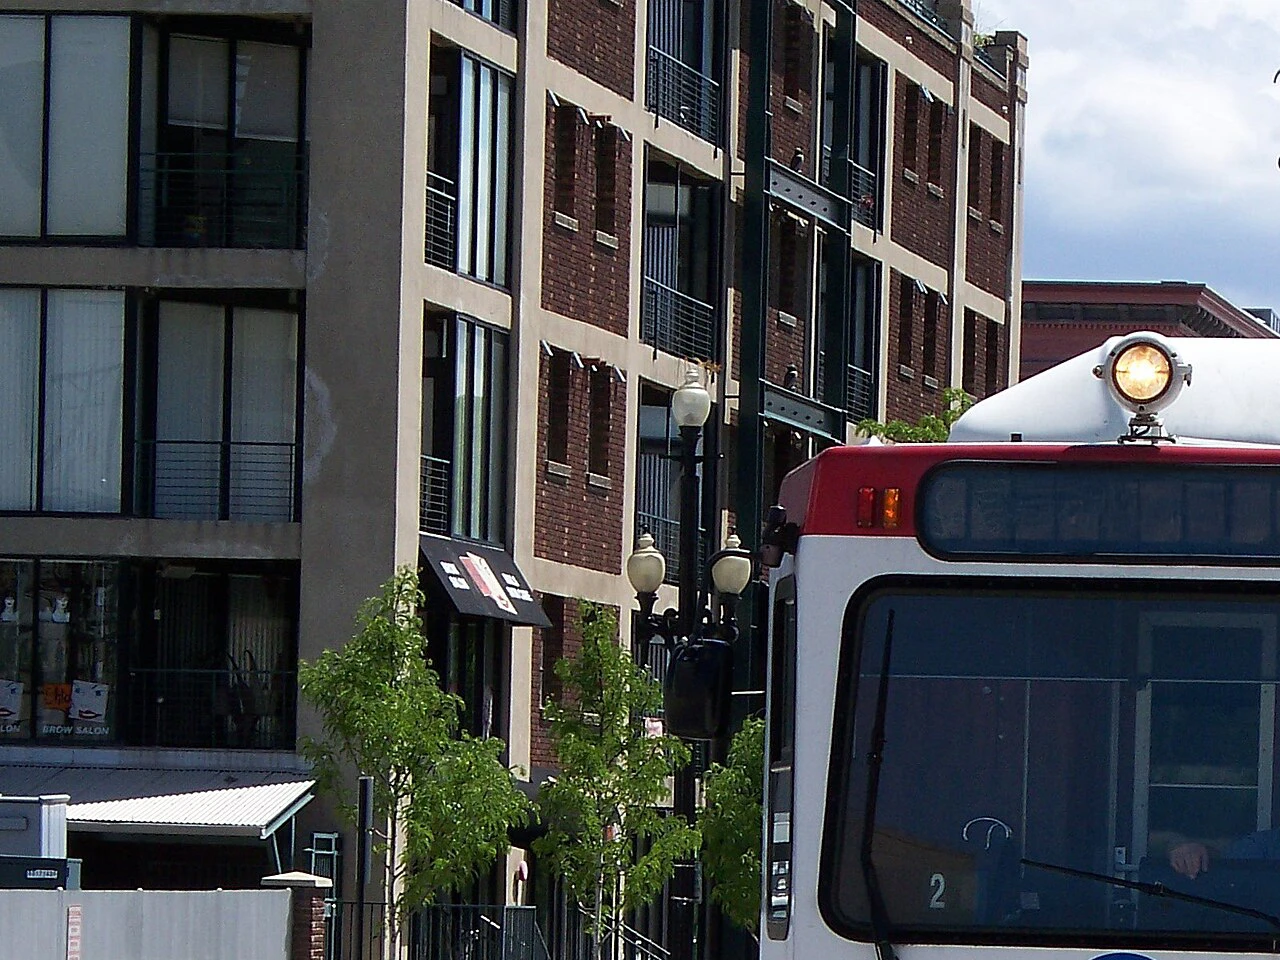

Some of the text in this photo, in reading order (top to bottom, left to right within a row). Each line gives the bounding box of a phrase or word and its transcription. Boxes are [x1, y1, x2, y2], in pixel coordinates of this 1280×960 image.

[42, 725, 110, 735] BROW SALON
[929, 873, 946, 908] 2
